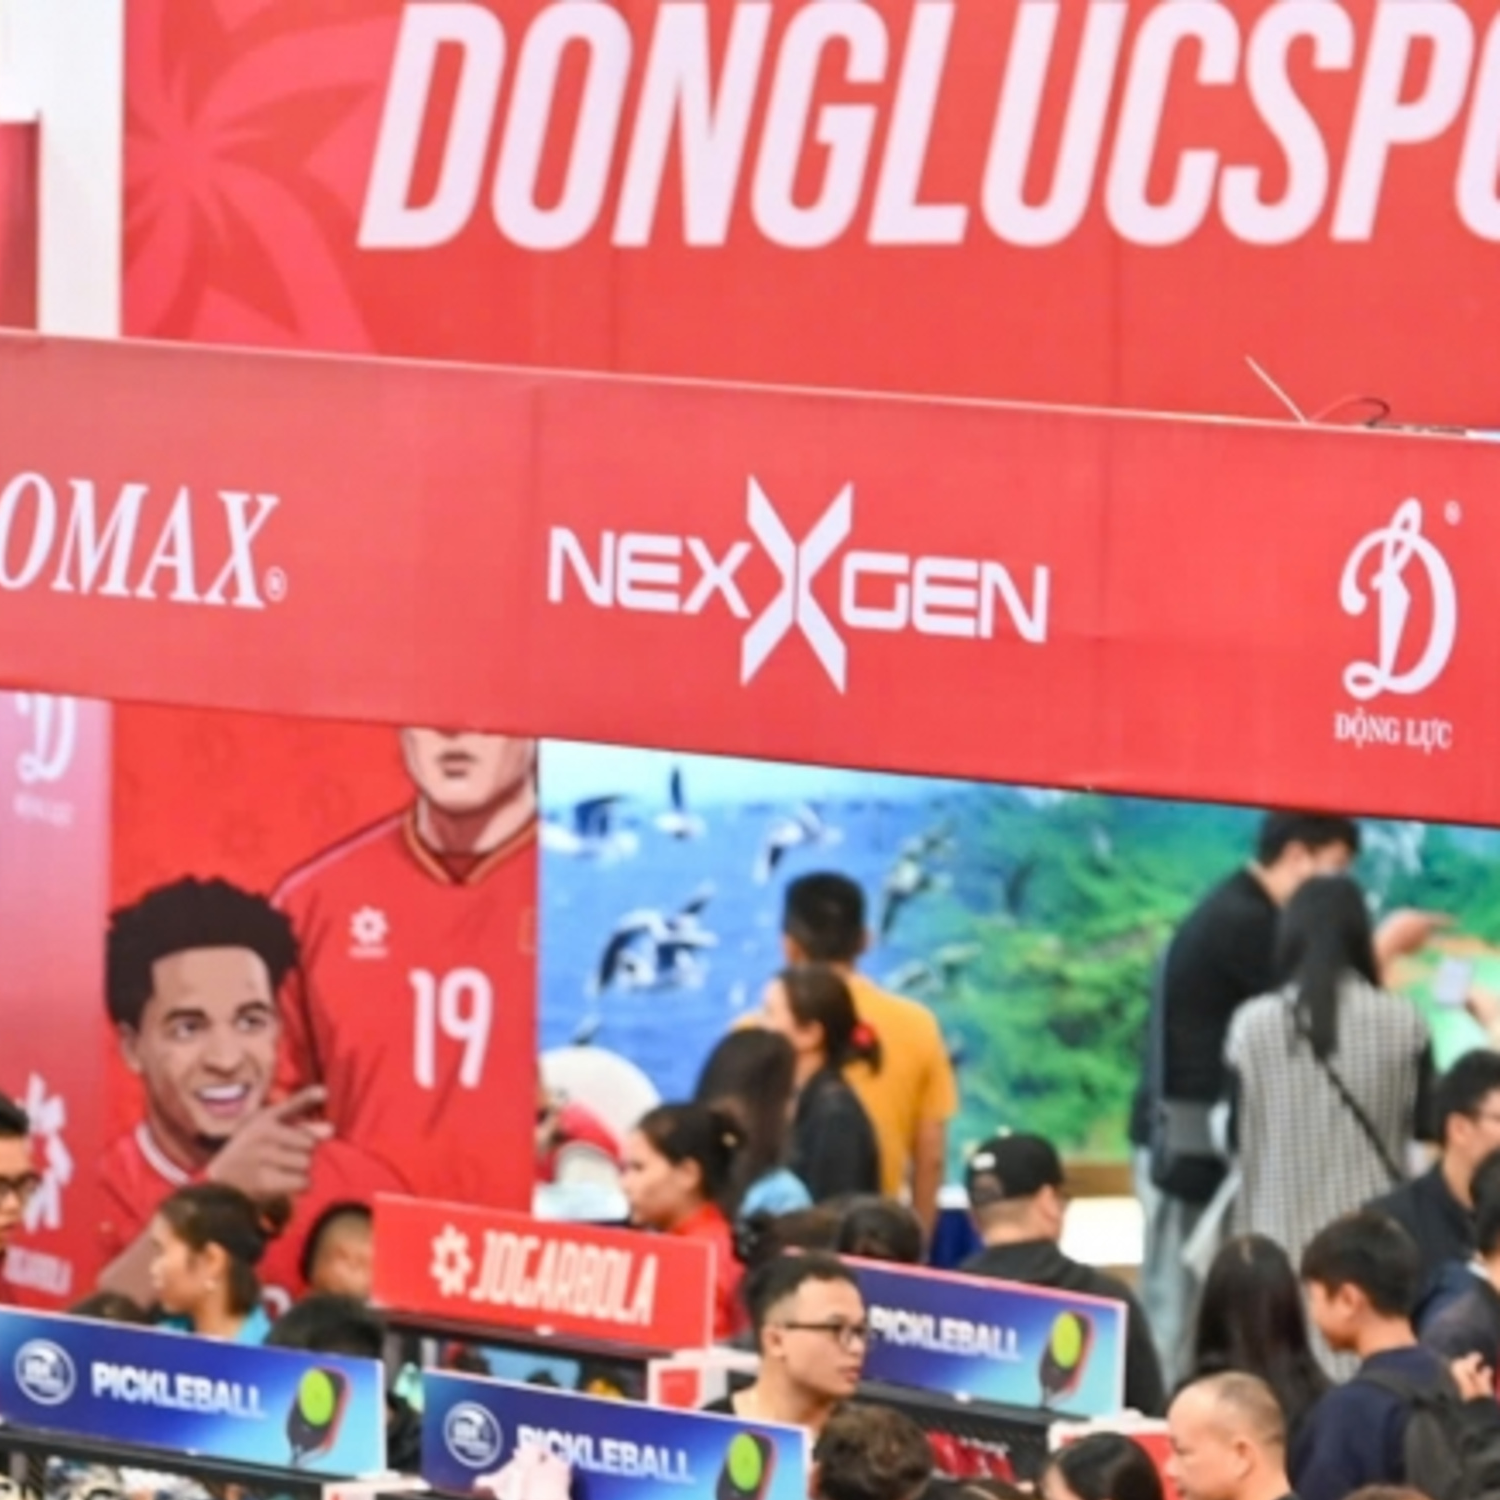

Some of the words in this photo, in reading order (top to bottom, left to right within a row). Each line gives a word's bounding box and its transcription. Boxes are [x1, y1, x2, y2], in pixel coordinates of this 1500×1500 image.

[407, 965, 494, 1091] 19
[468, 1230, 658, 1328] JOGARBOLA
[870, 1306, 1021, 1363] PICKLEBALL
[91, 1361, 266, 1420] PICKLEBALL
